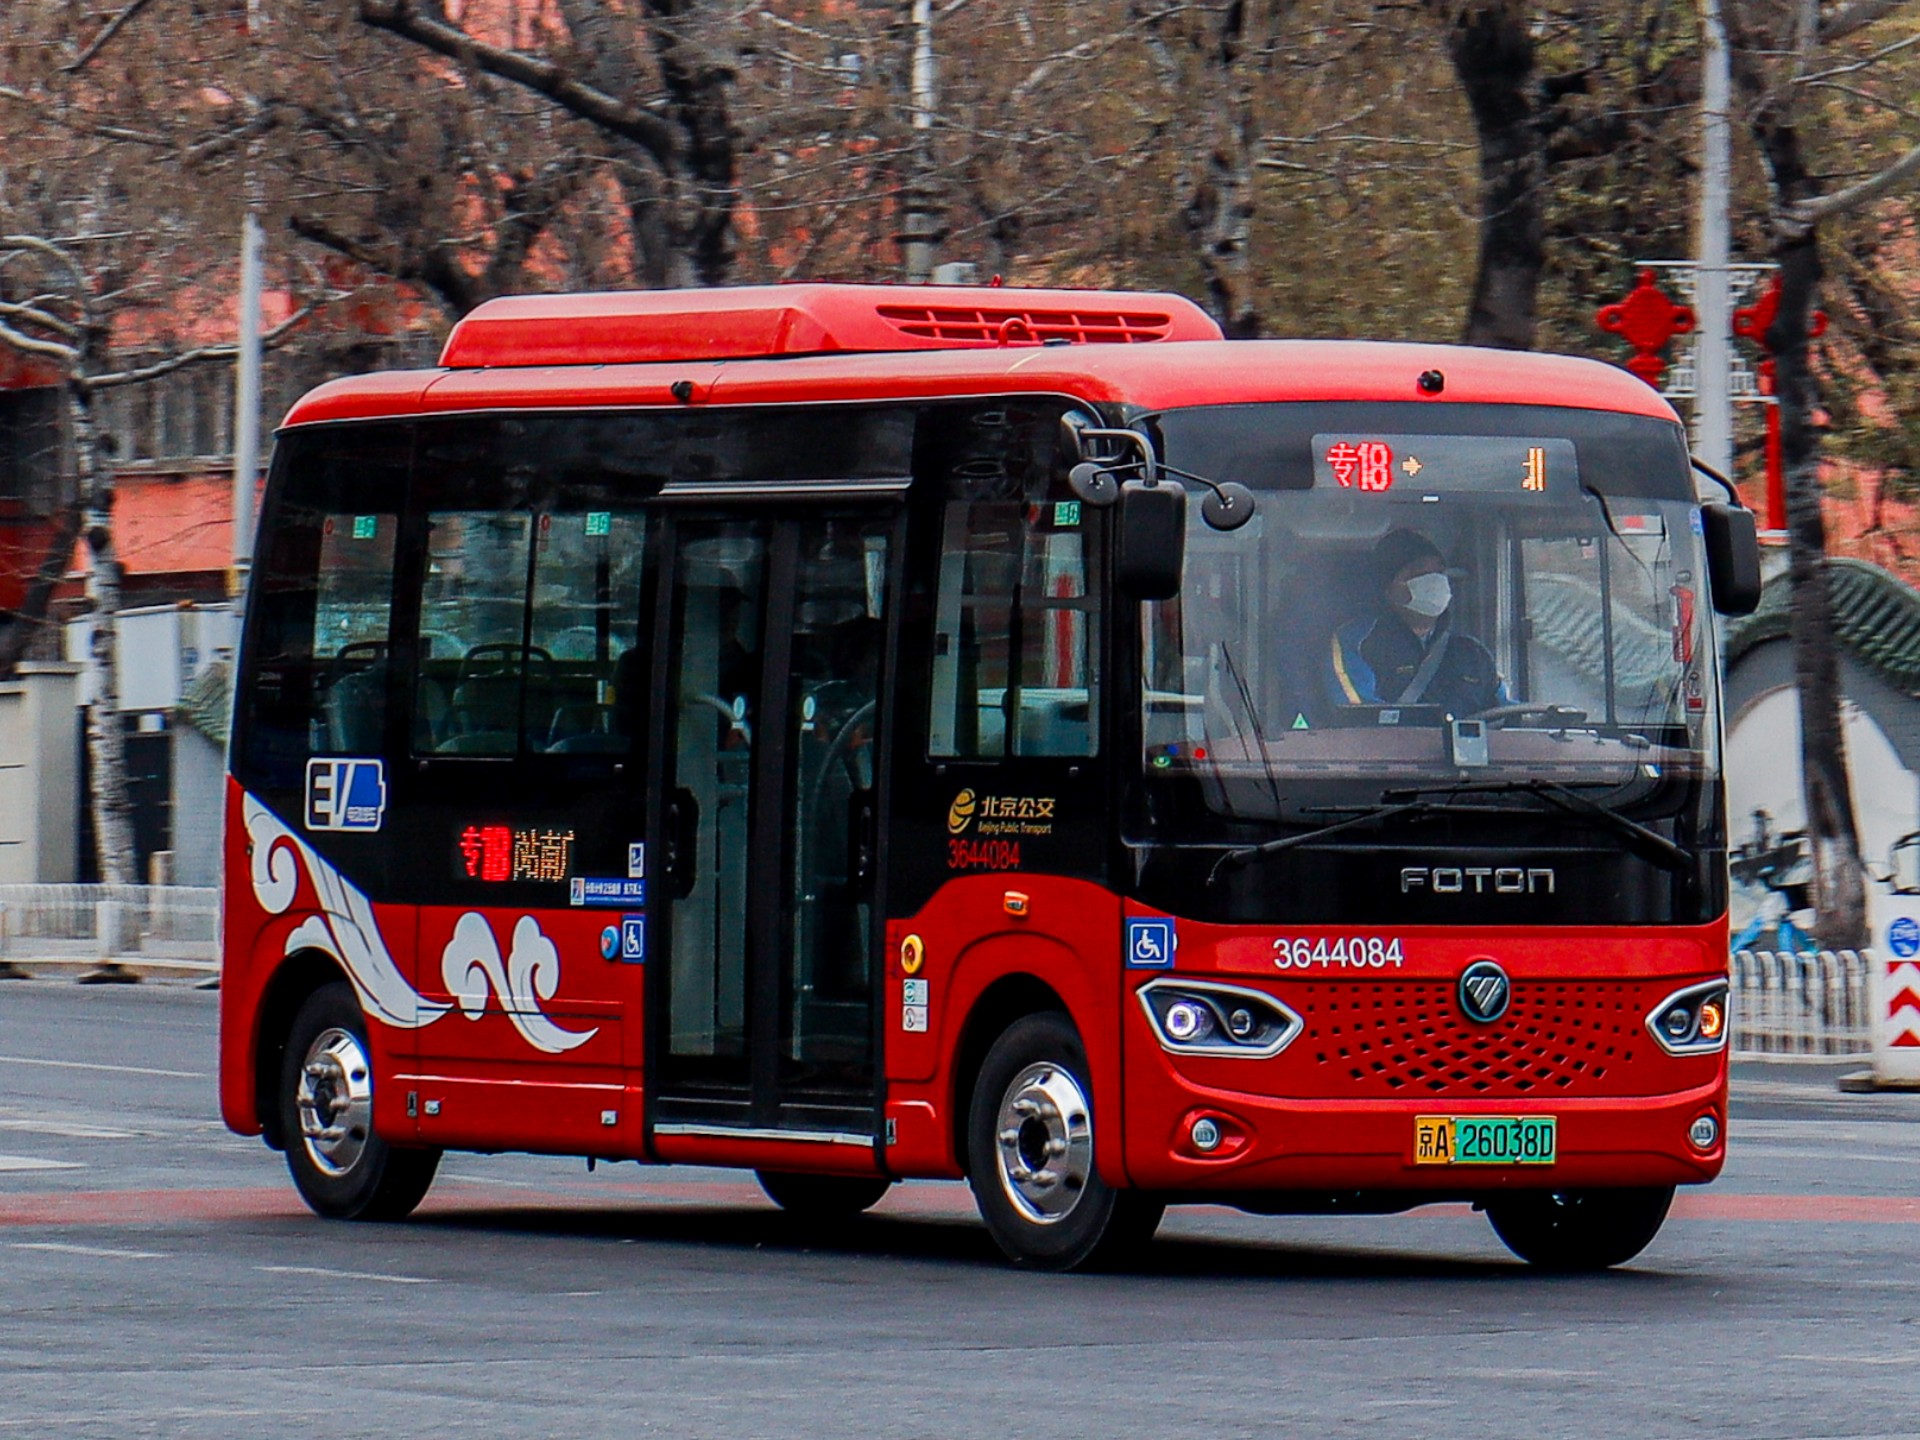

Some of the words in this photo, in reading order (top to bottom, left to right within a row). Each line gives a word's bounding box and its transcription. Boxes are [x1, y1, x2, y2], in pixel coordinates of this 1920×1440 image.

[1327, 443, 1389, 491] 专18
[979, 796, 1056, 818] 北京公交
[947, 839, 1020, 869] 3644084
[1400, 867, 1555, 893] FOTON
[1272, 937, 1404, 970] 3644084
[1419, 1125, 1449, 1158] 京A
[1462, 1124, 1554, 1157] 26038D
